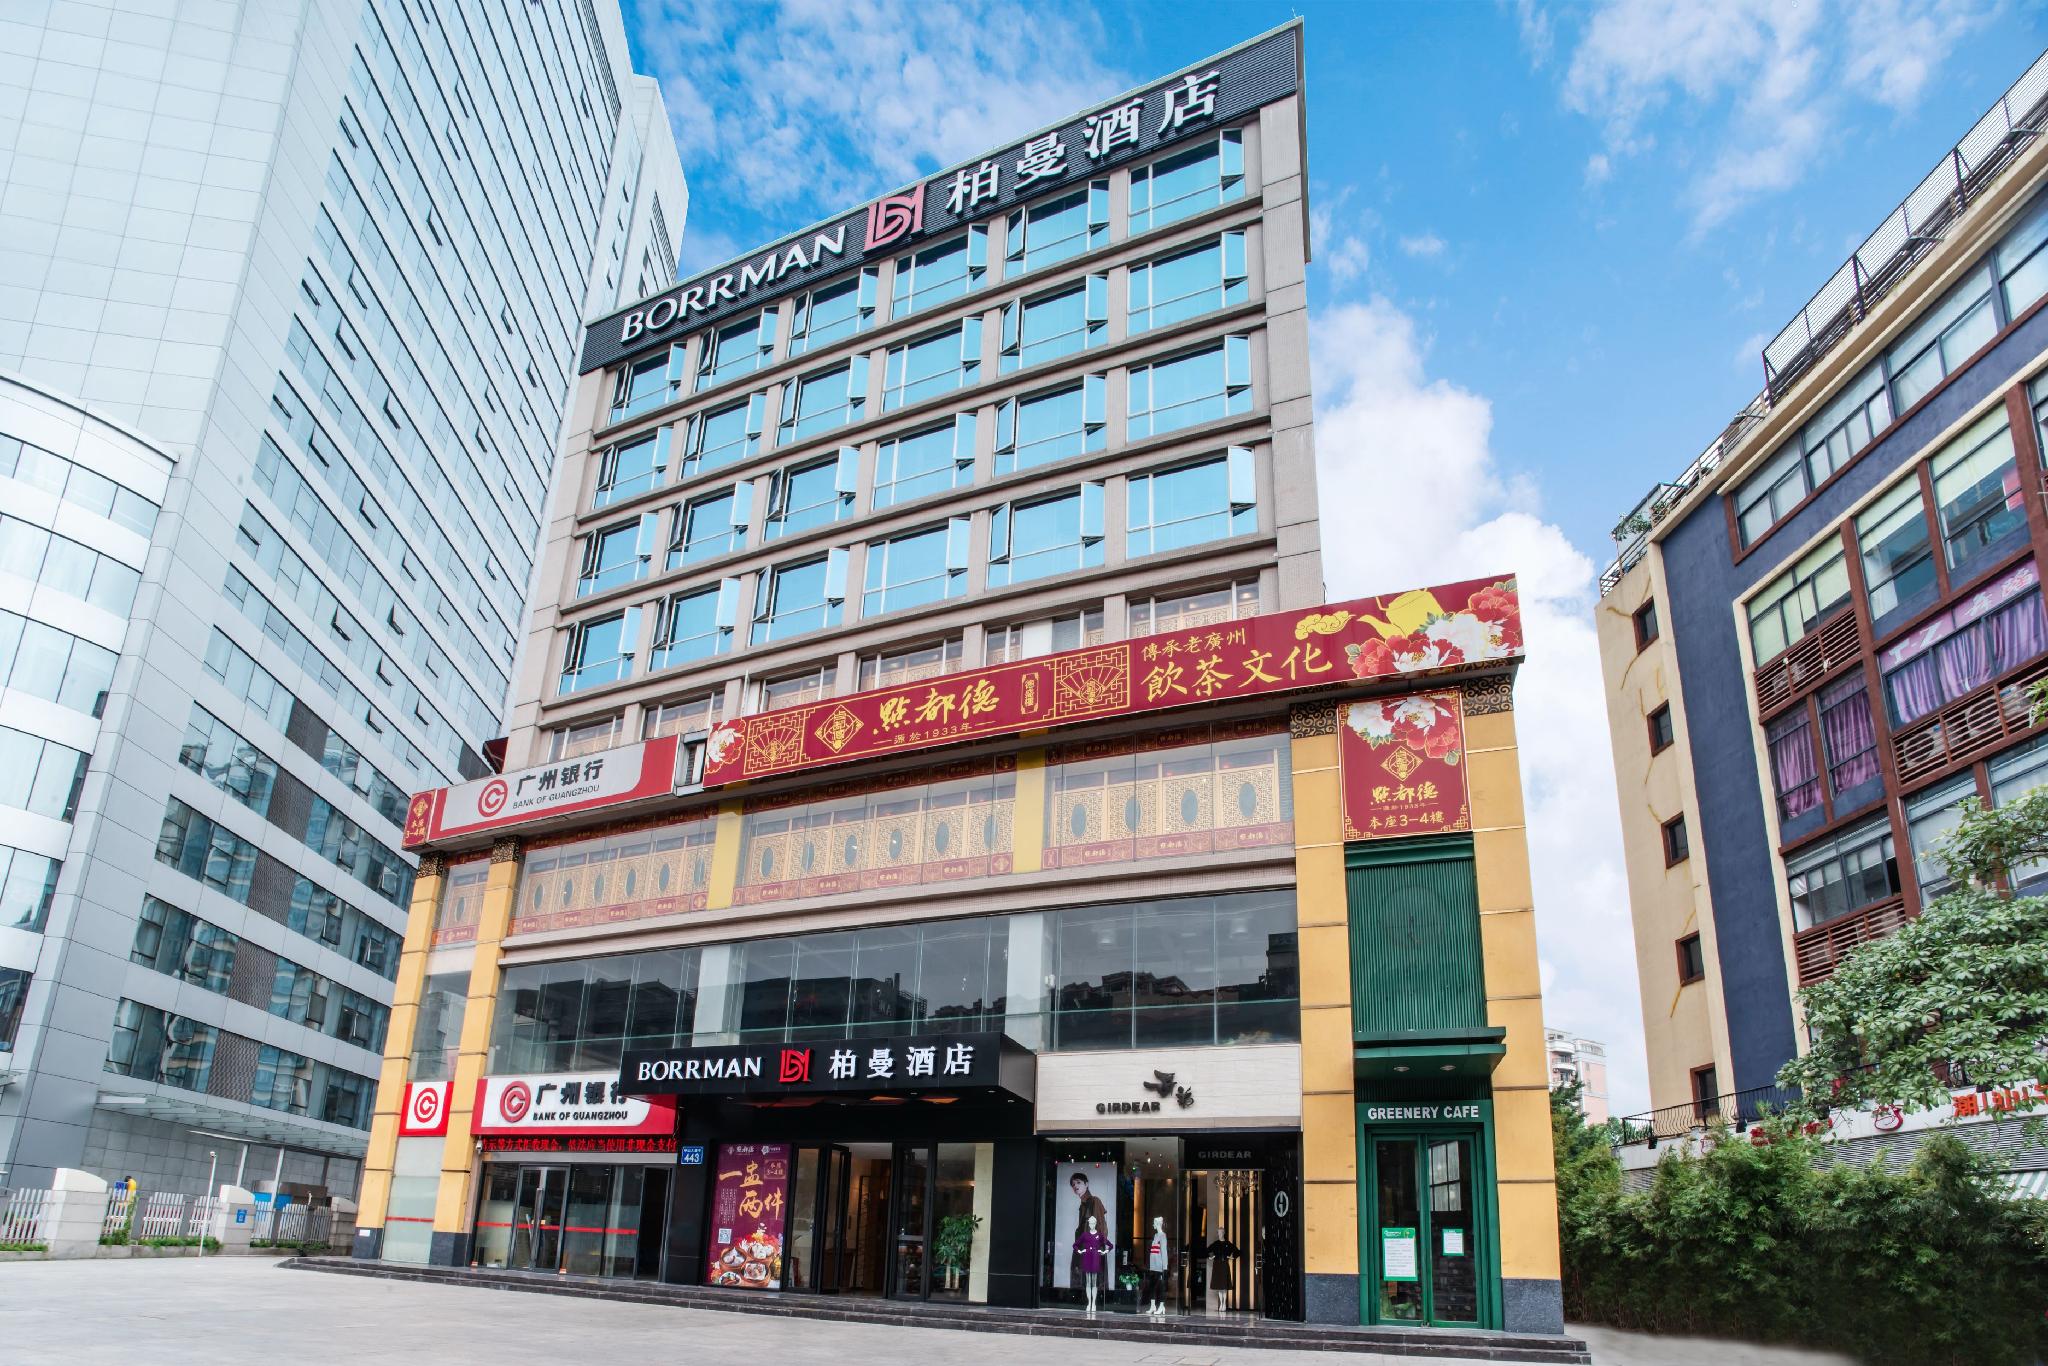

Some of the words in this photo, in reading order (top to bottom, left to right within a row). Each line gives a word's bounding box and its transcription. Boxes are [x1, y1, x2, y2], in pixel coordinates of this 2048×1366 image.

[946, 71, 1221, 214] 柏曼酒店
[620, 225, 847, 345] BORRMAN
[1141, 627, 1247, 662] 傳承老廣州
[1141, 642, 1333, 702] 飲茶文化
[516, 758, 604, 797] 广州银行
[513, 799, 534, 810] BANK
[536, 796, 547, 804] OF
[549, 785, 600, 801] GUANGZHOU
[638, 1056, 762, 1081] BORRMAN
[829, 1043, 974, 1080] 柏曼酒店
[532, 1111, 556, 1121] BANK
[559, 1111, 571, 1120] OF
[573, 1110, 629, 1120] GUANGZHOU
[1096, 1101, 1161, 1115] GIRDEAR
[1368, 1106, 1439, 1120] GREENERY
[1443, 1105, 1479, 1118] CAFE
[684, 1153, 700, 1163] 443
[1198, 1151, 1252, 1160] GIRDEAR
